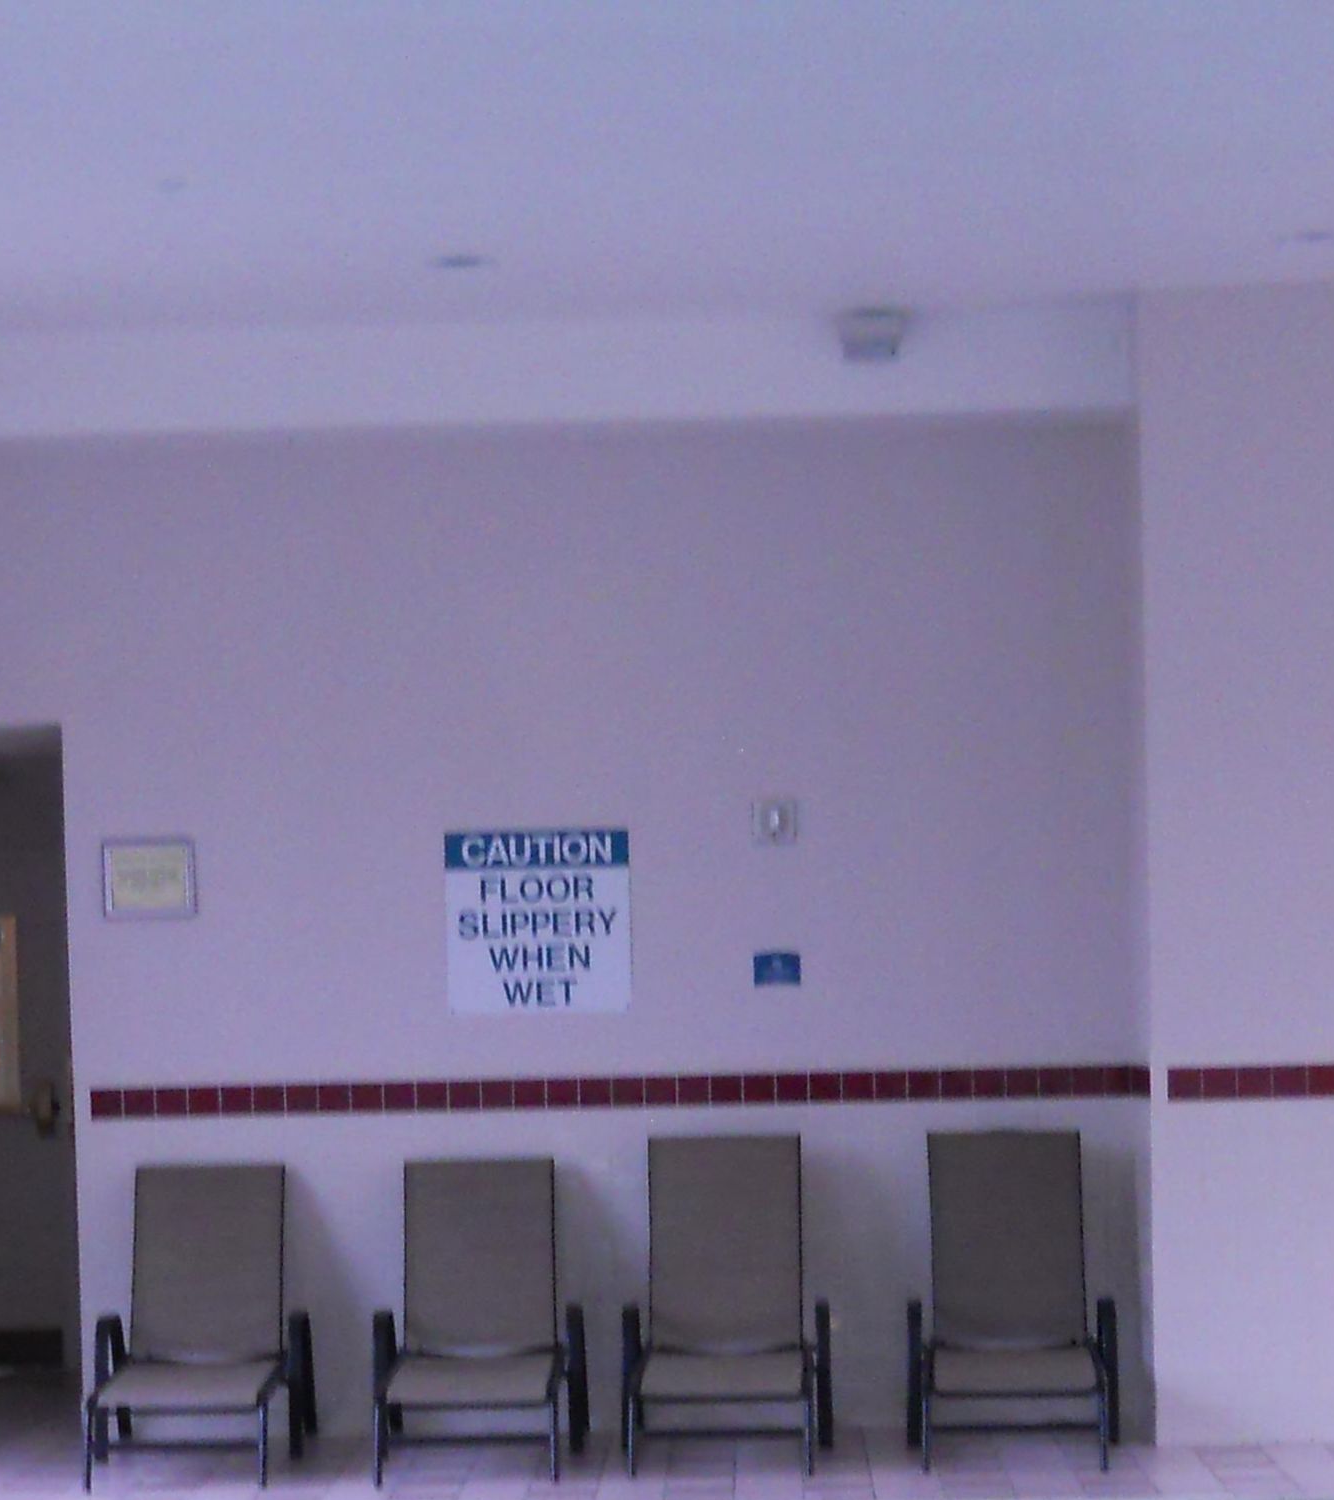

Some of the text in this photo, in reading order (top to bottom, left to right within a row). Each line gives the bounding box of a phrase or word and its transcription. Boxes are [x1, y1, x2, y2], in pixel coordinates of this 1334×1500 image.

[461, 833, 613, 867] CAUTION
[480, 874, 594, 903] FLOOR
[458, 908, 617, 941] SLIPPERY
[489, 943, 591, 973] WHEN
[503, 978, 578, 1007] WET
